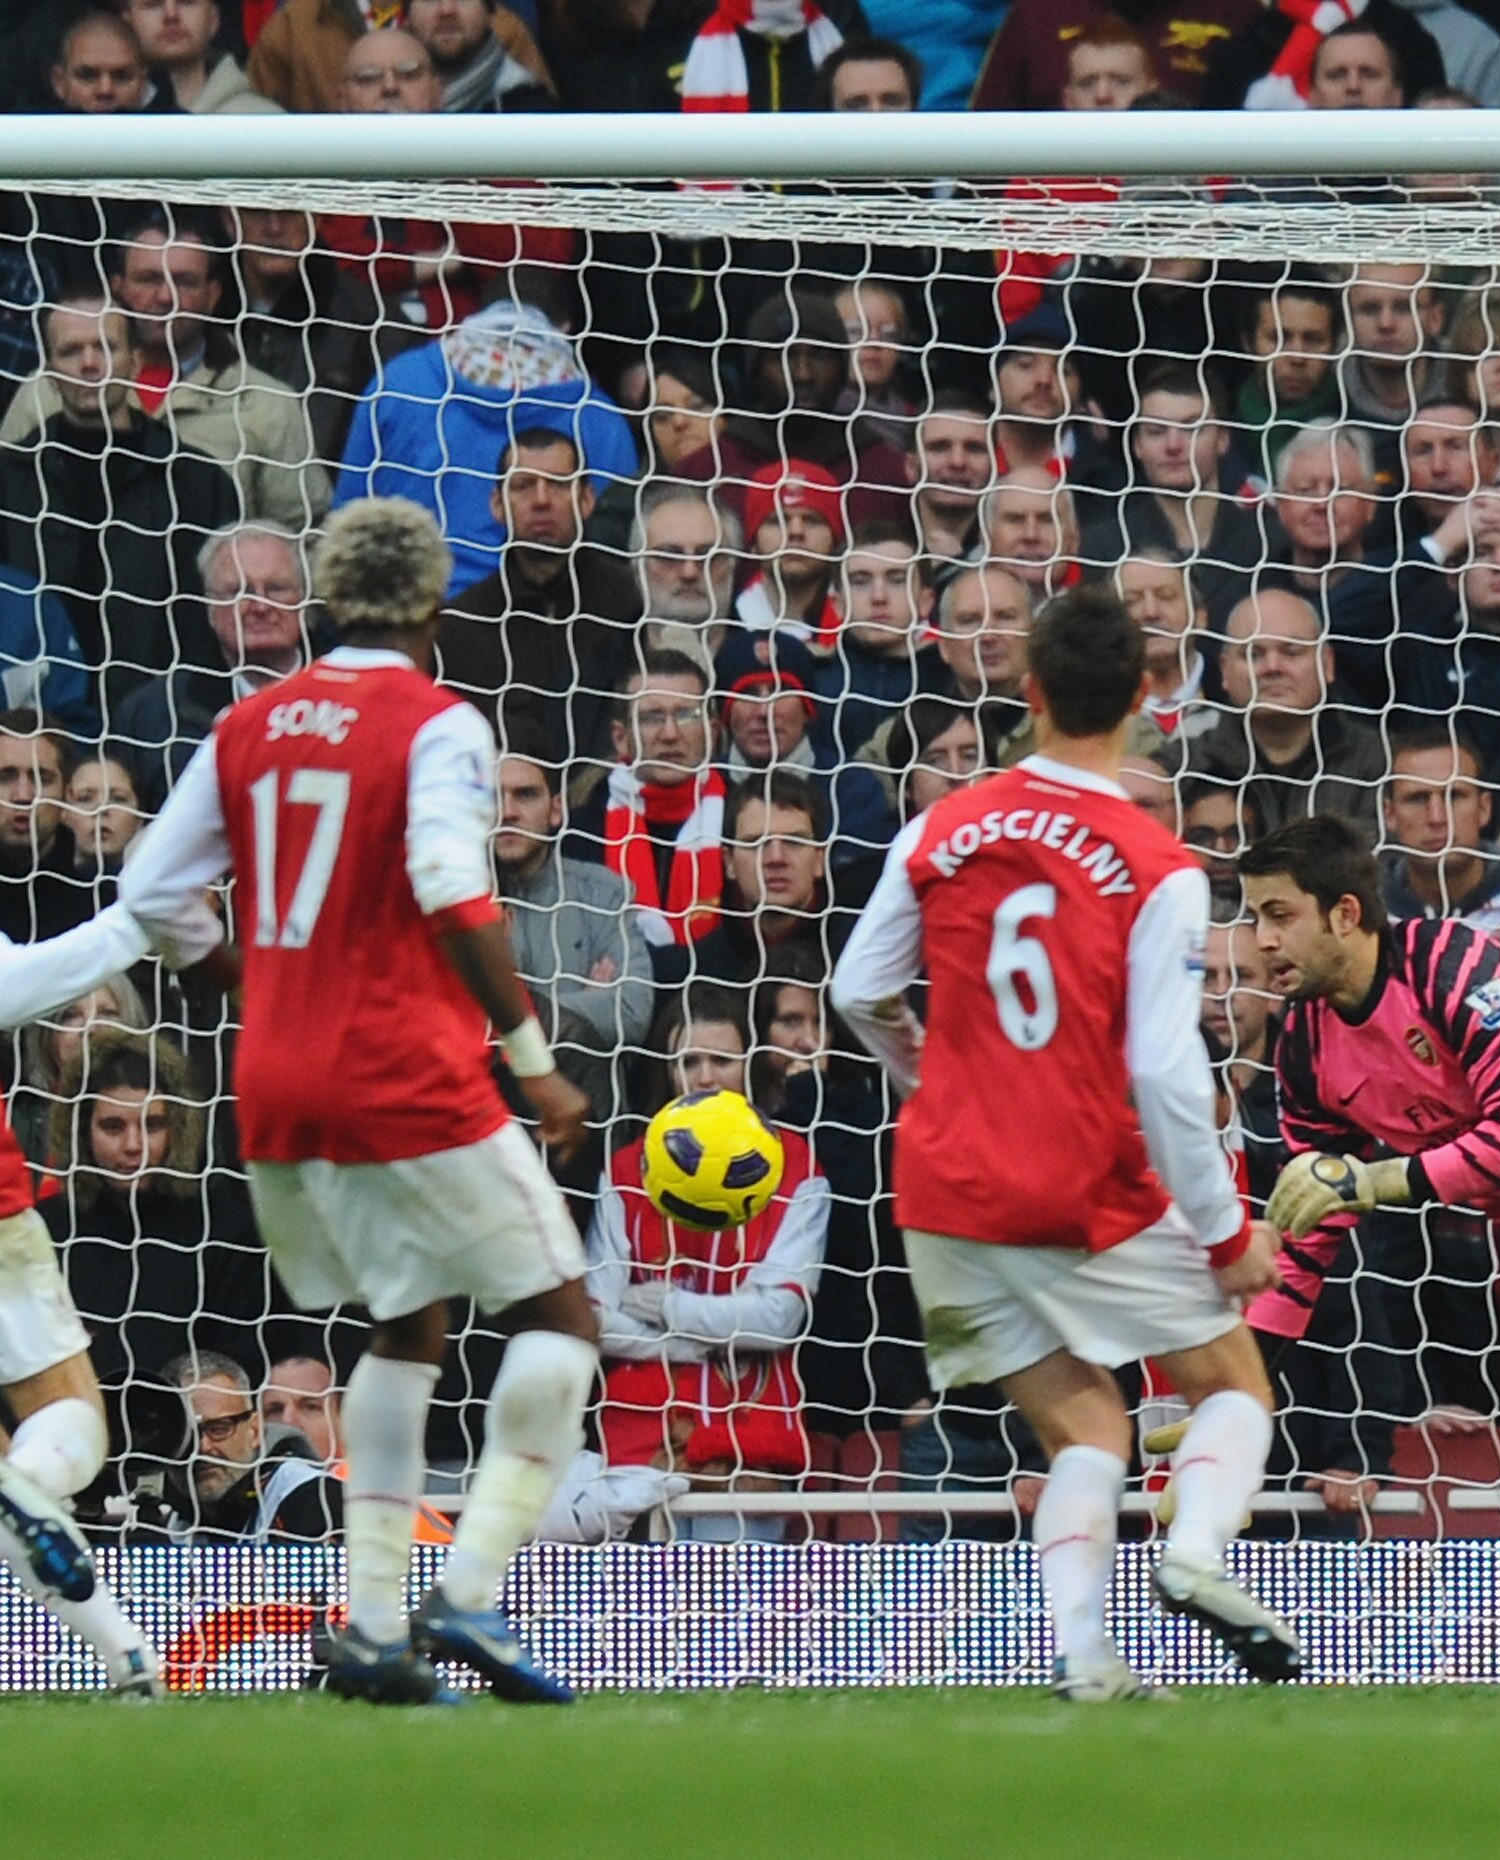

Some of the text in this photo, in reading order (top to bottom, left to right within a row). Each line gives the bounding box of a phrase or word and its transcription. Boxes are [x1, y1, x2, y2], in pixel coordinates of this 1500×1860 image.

[266, 699, 359, 745] SONG
[249, 769, 351, 949] 17
[928, 809, 1137, 897] KOSCIELNY
[986, 881, 1059, 1051] 6
